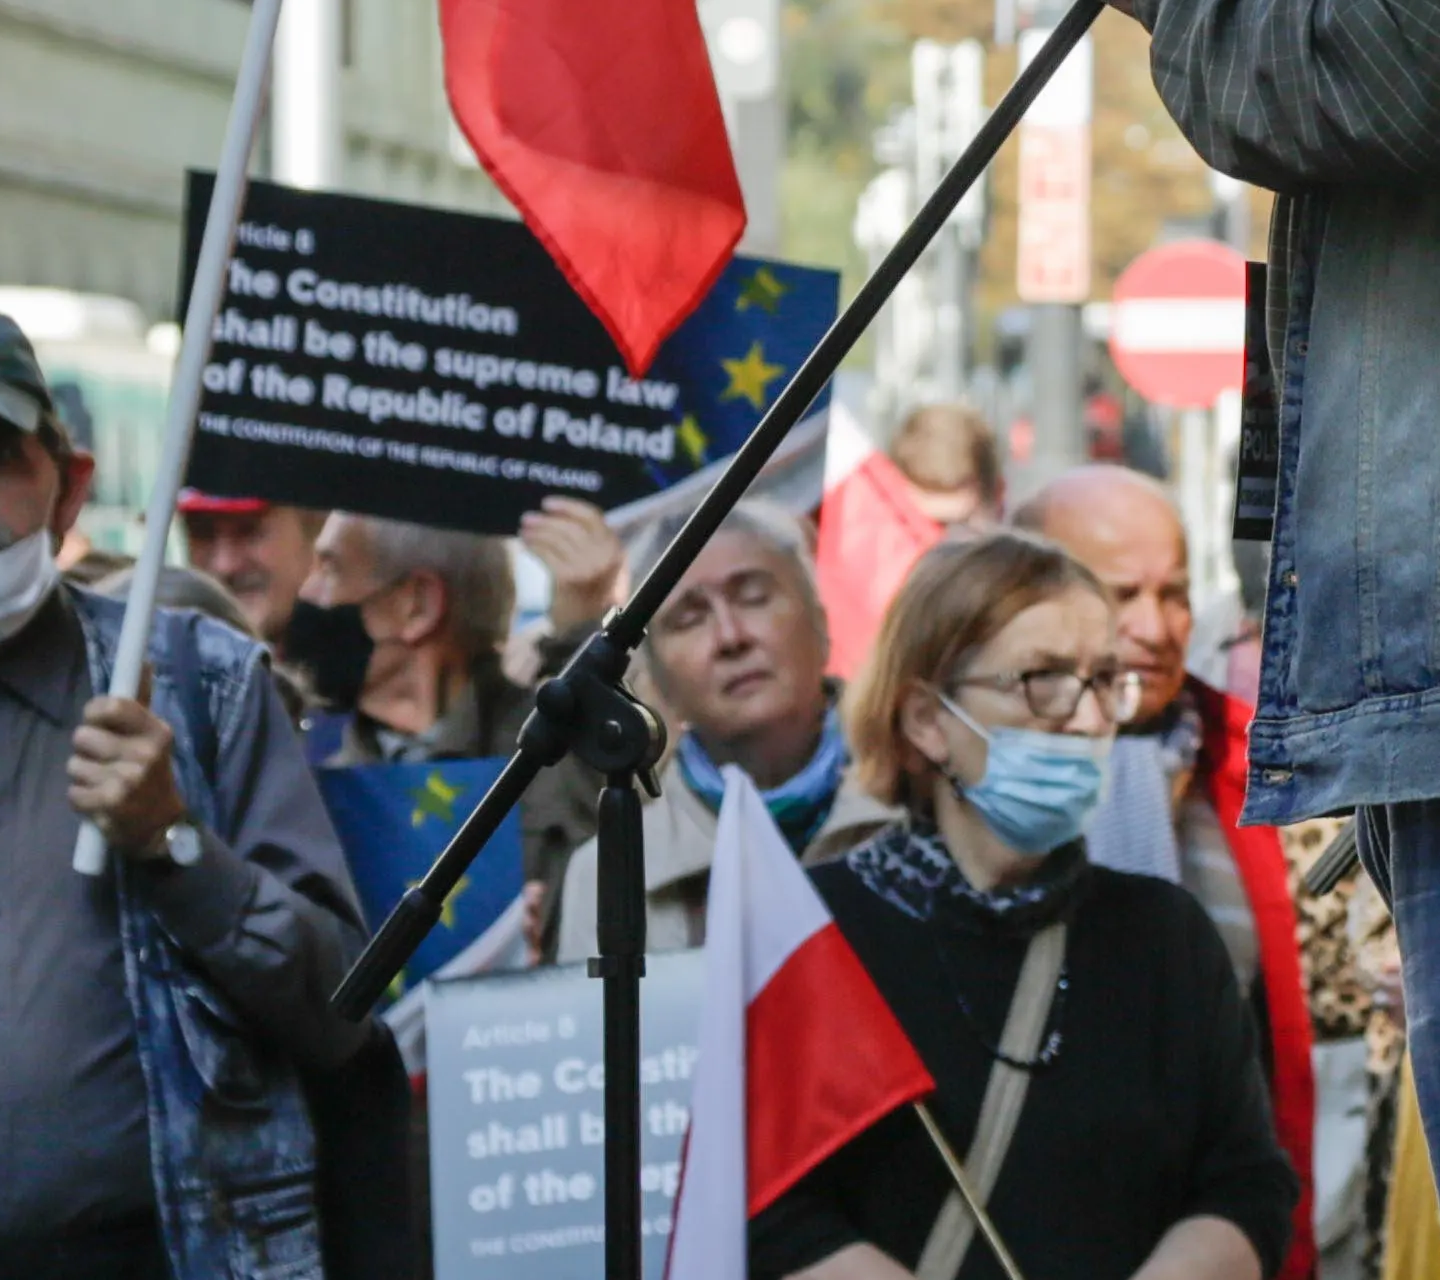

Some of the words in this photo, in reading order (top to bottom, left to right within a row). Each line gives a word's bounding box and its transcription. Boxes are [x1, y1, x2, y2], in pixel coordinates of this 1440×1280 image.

[295, 228, 315, 255] 8
[228, 257, 281, 300] he
[286, 267, 518, 336] Constitution
[303, 317, 357, 362] be
[362, 330, 428, 373] the
[434, 347, 600, 399] supreme
[606, 365, 679, 410] law
[202, 357, 246, 395] of
[249, 362, 316, 407] the
[321, 372, 487, 432] Republic
[492, 401, 538, 440] of
[542, 406, 676, 462] Poland
[231, 416, 356, 455] CONSTITUTION
[357, 435, 384, 459] OF
[385, 439, 420, 465] THE
[419, 445, 498, 478] REPUBLIC
[500, 457, 527, 480] OF
[527, 461, 604, 493] POLAND
[461, 1019, 551, 1051] Article
[461, 1066, 543, 1106] The
[465, 1113, 569, 1159] shall
[579, 1110, 605, 1145] b
[467, 1171, 515, 1213] of
[522, 1167, 596, 1207] the
